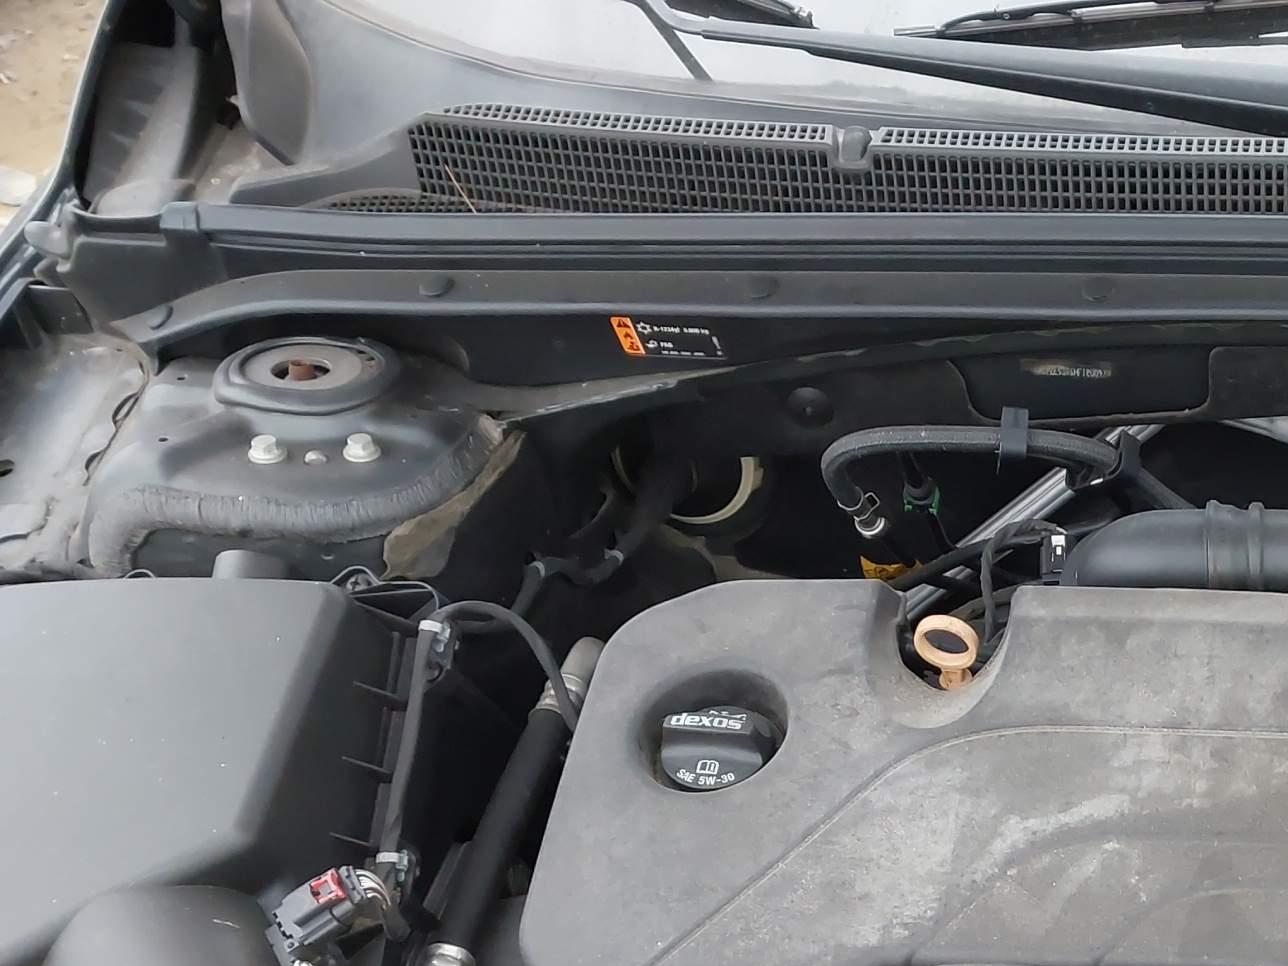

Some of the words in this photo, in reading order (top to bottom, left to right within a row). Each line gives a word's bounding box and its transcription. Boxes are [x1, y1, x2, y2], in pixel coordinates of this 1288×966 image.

[670, 713, 745, 730] dexos
[676, 768, 696, 783] SAE
[698, 772, 735, 785] 5W-30
